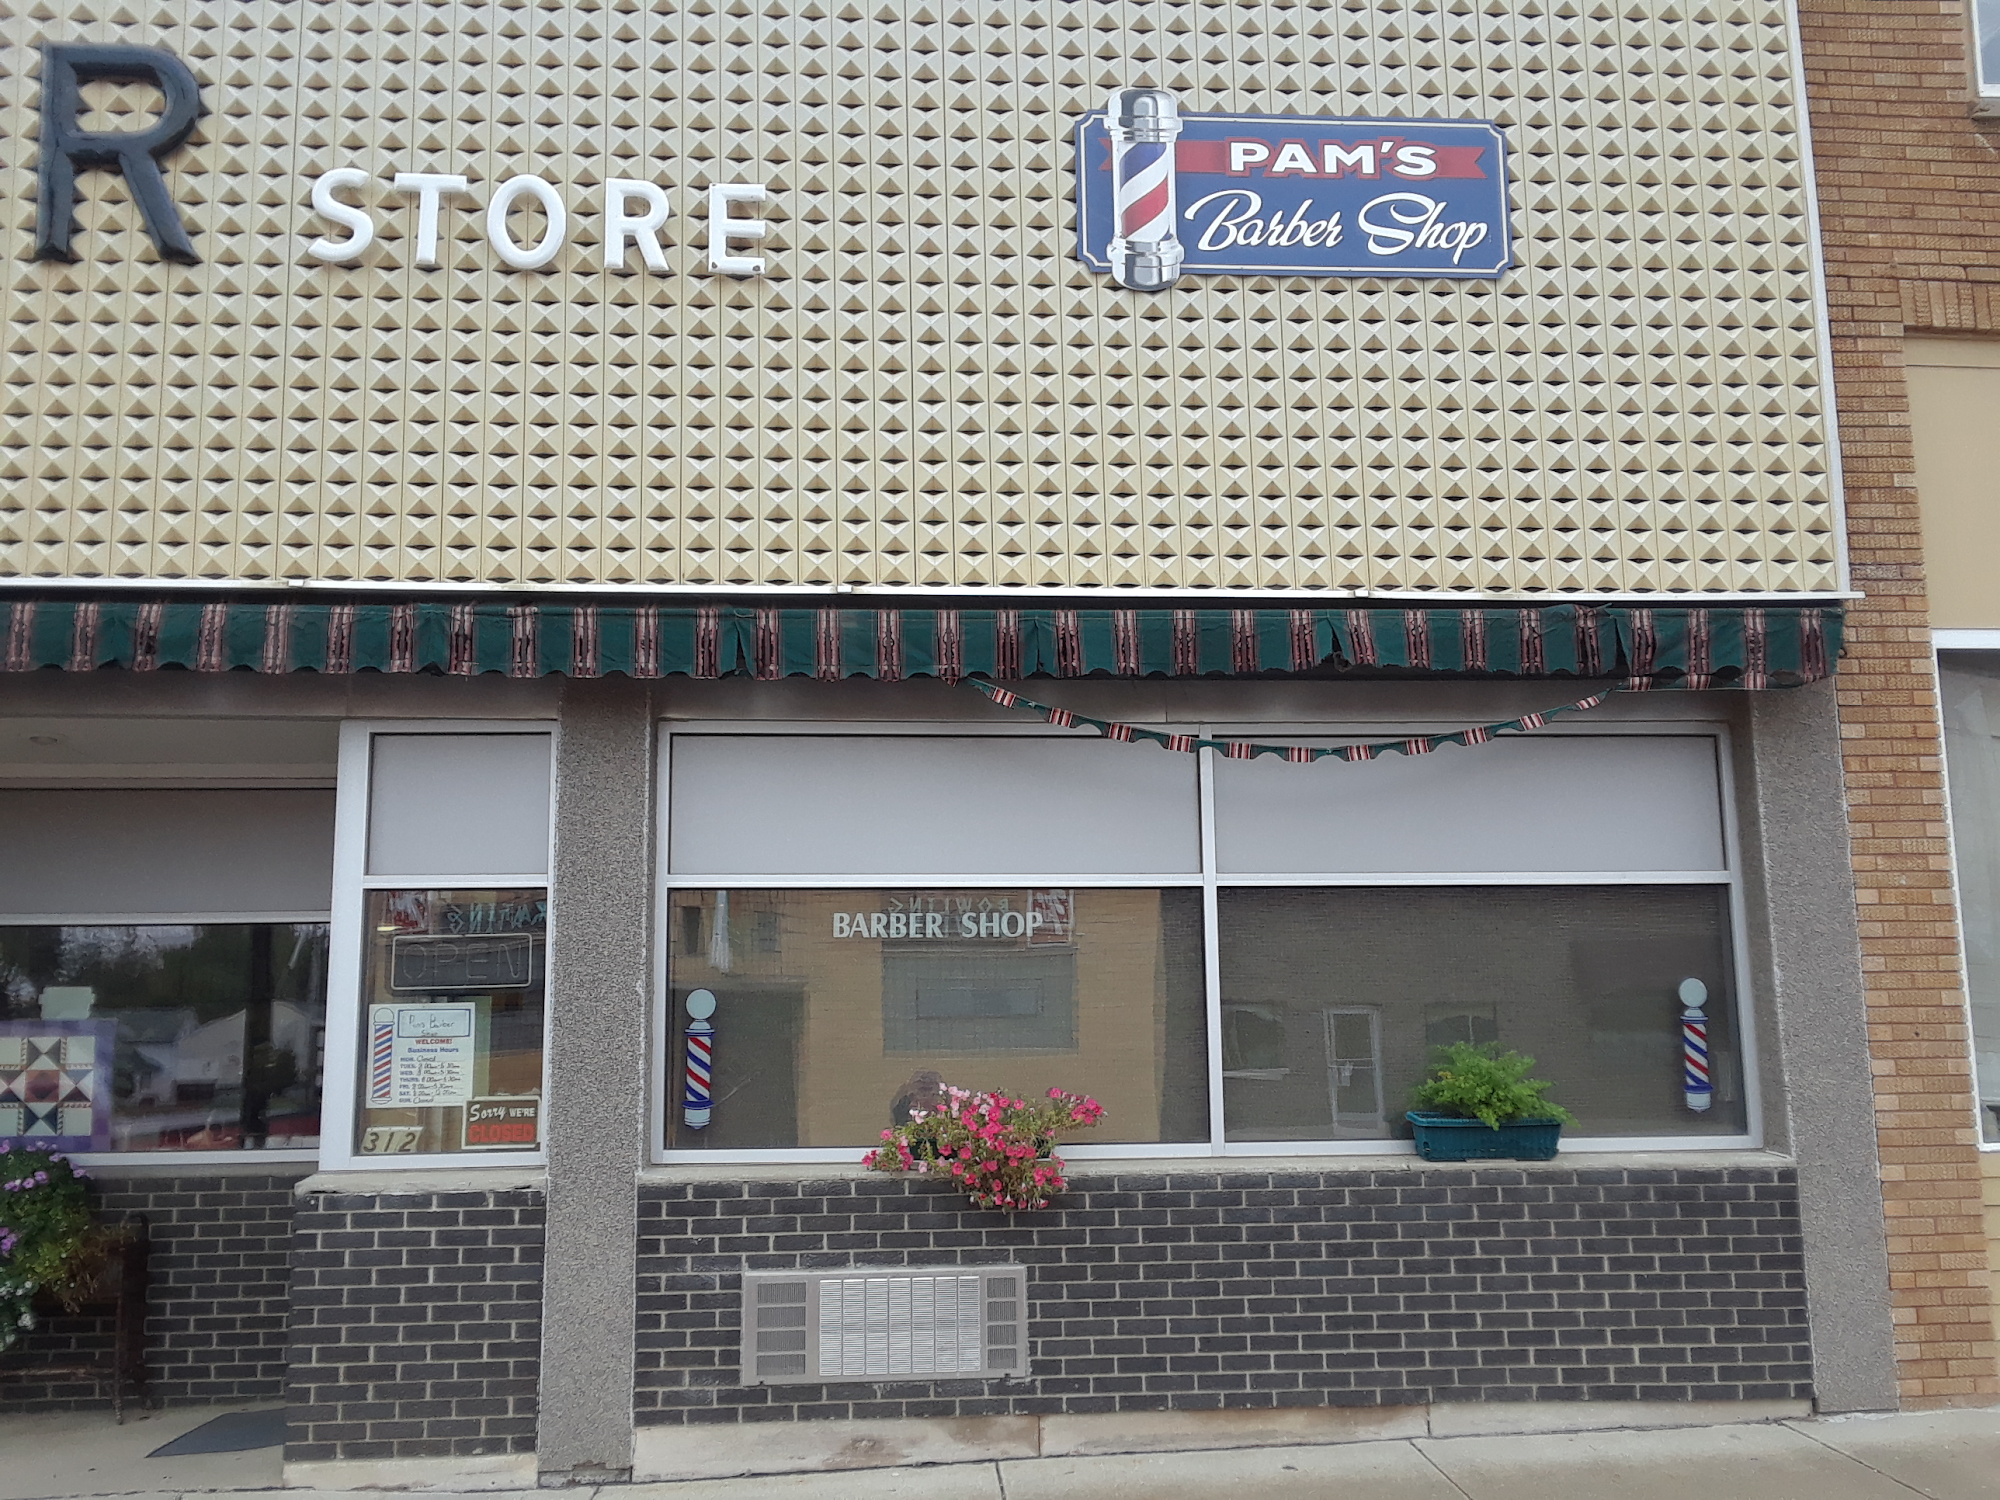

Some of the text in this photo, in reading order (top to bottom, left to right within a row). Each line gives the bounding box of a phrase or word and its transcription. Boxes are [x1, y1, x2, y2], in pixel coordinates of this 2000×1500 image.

[38, 42, 206, 265] R
[1229, 140, 1438, 177] PAM'S
[307, 167, 768, 276] STORE
[1184, 189, 1488, 265] Barber Shop
[832, 912, 944, 939] BARBER
[961, 911, 1044, 939] SHOP
[402, 942, 522, 980] OPEN
[469, 1104, 536, 1122] Sorry WE'RE
[362, 1131, 417, 1153] 312
[467, 1123, 536, 1143] CLOSED
